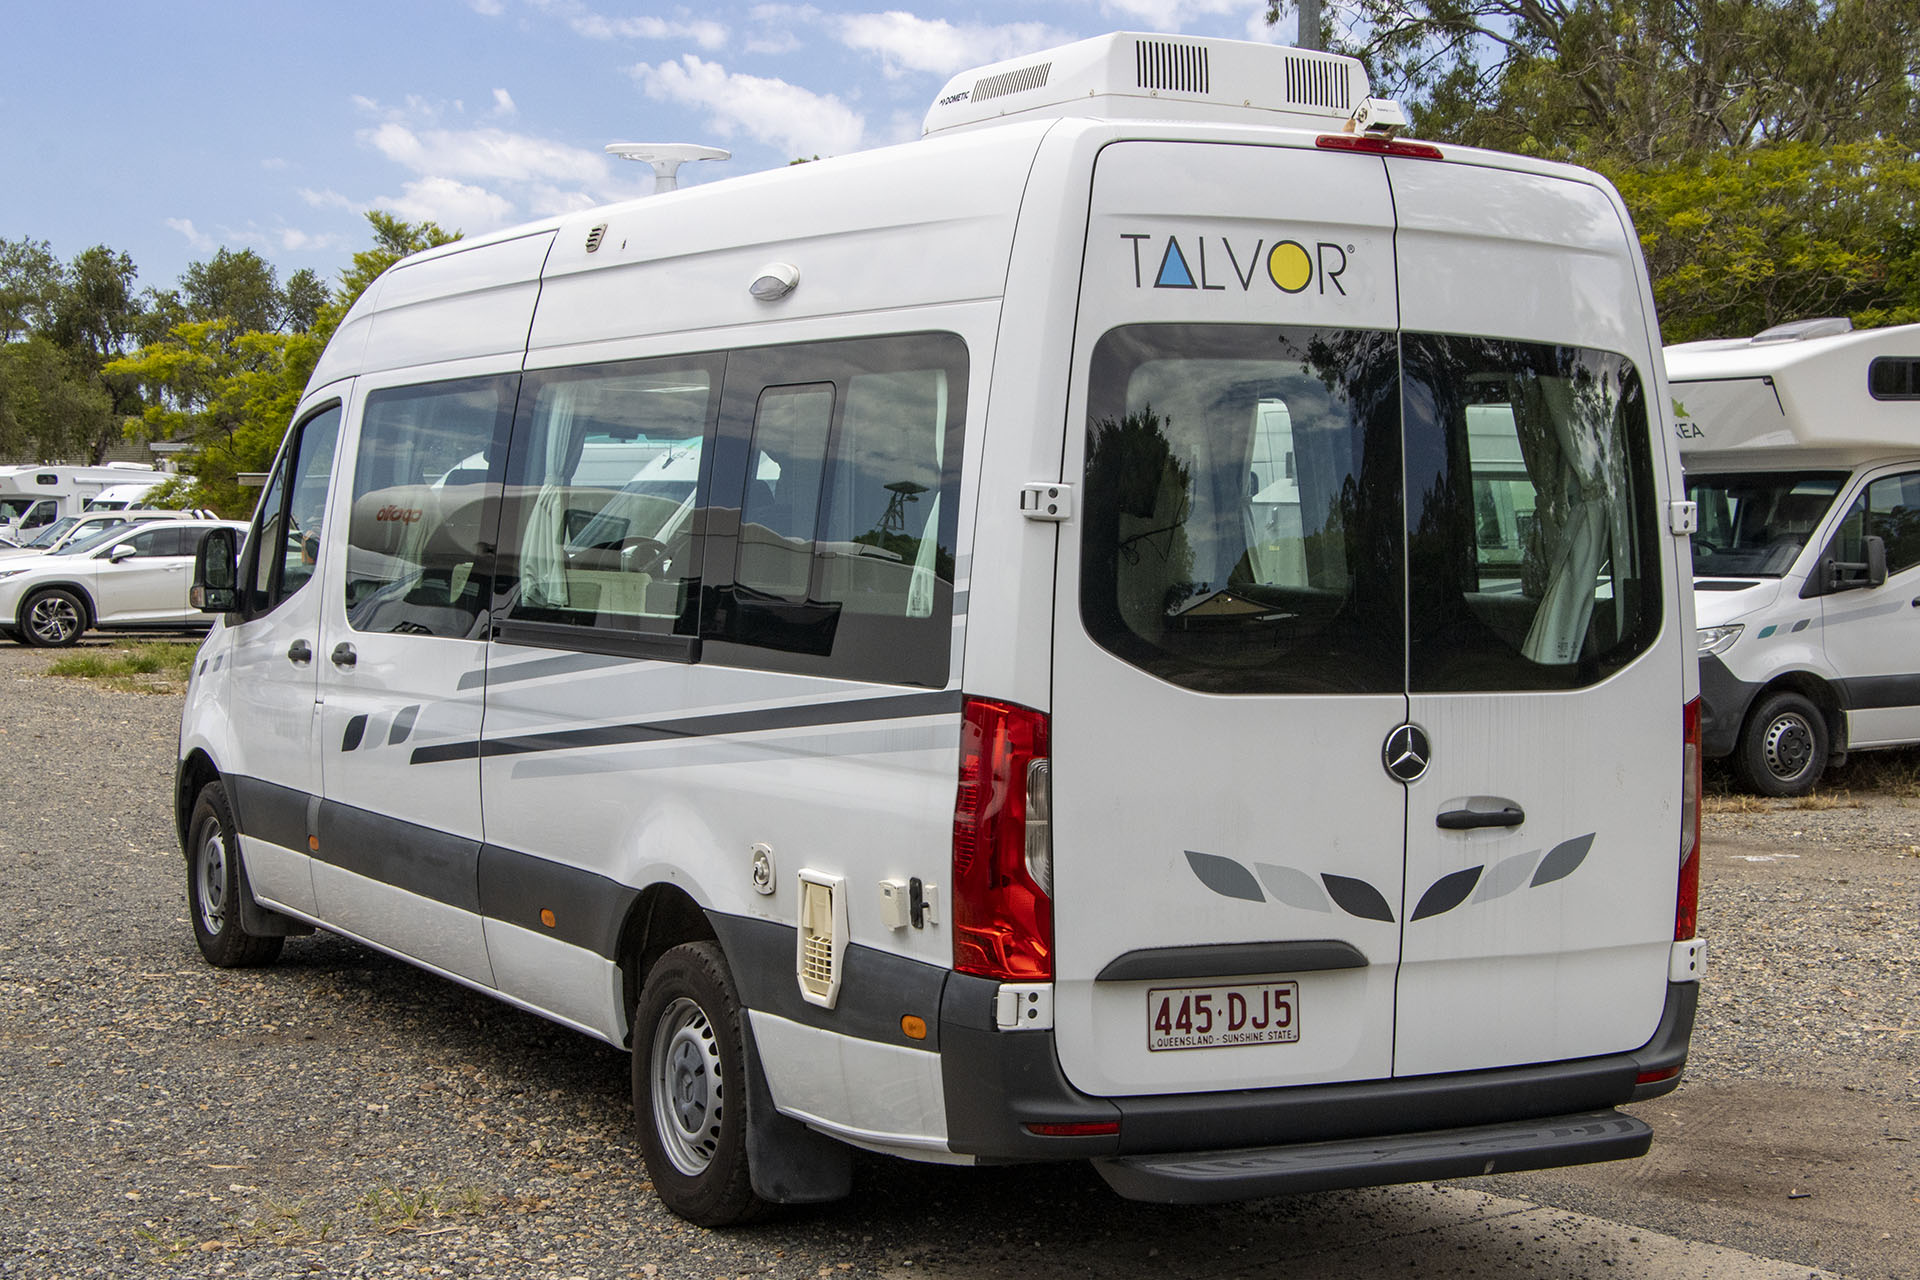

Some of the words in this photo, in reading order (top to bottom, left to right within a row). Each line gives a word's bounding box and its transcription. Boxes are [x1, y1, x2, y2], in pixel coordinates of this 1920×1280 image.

[1156, 1035, 1214, 1048] QUEENSLAND
[1222, 1031, 1264, 1044] SUNSHINE
[1267, 1029, 1292, 1041] STATE
